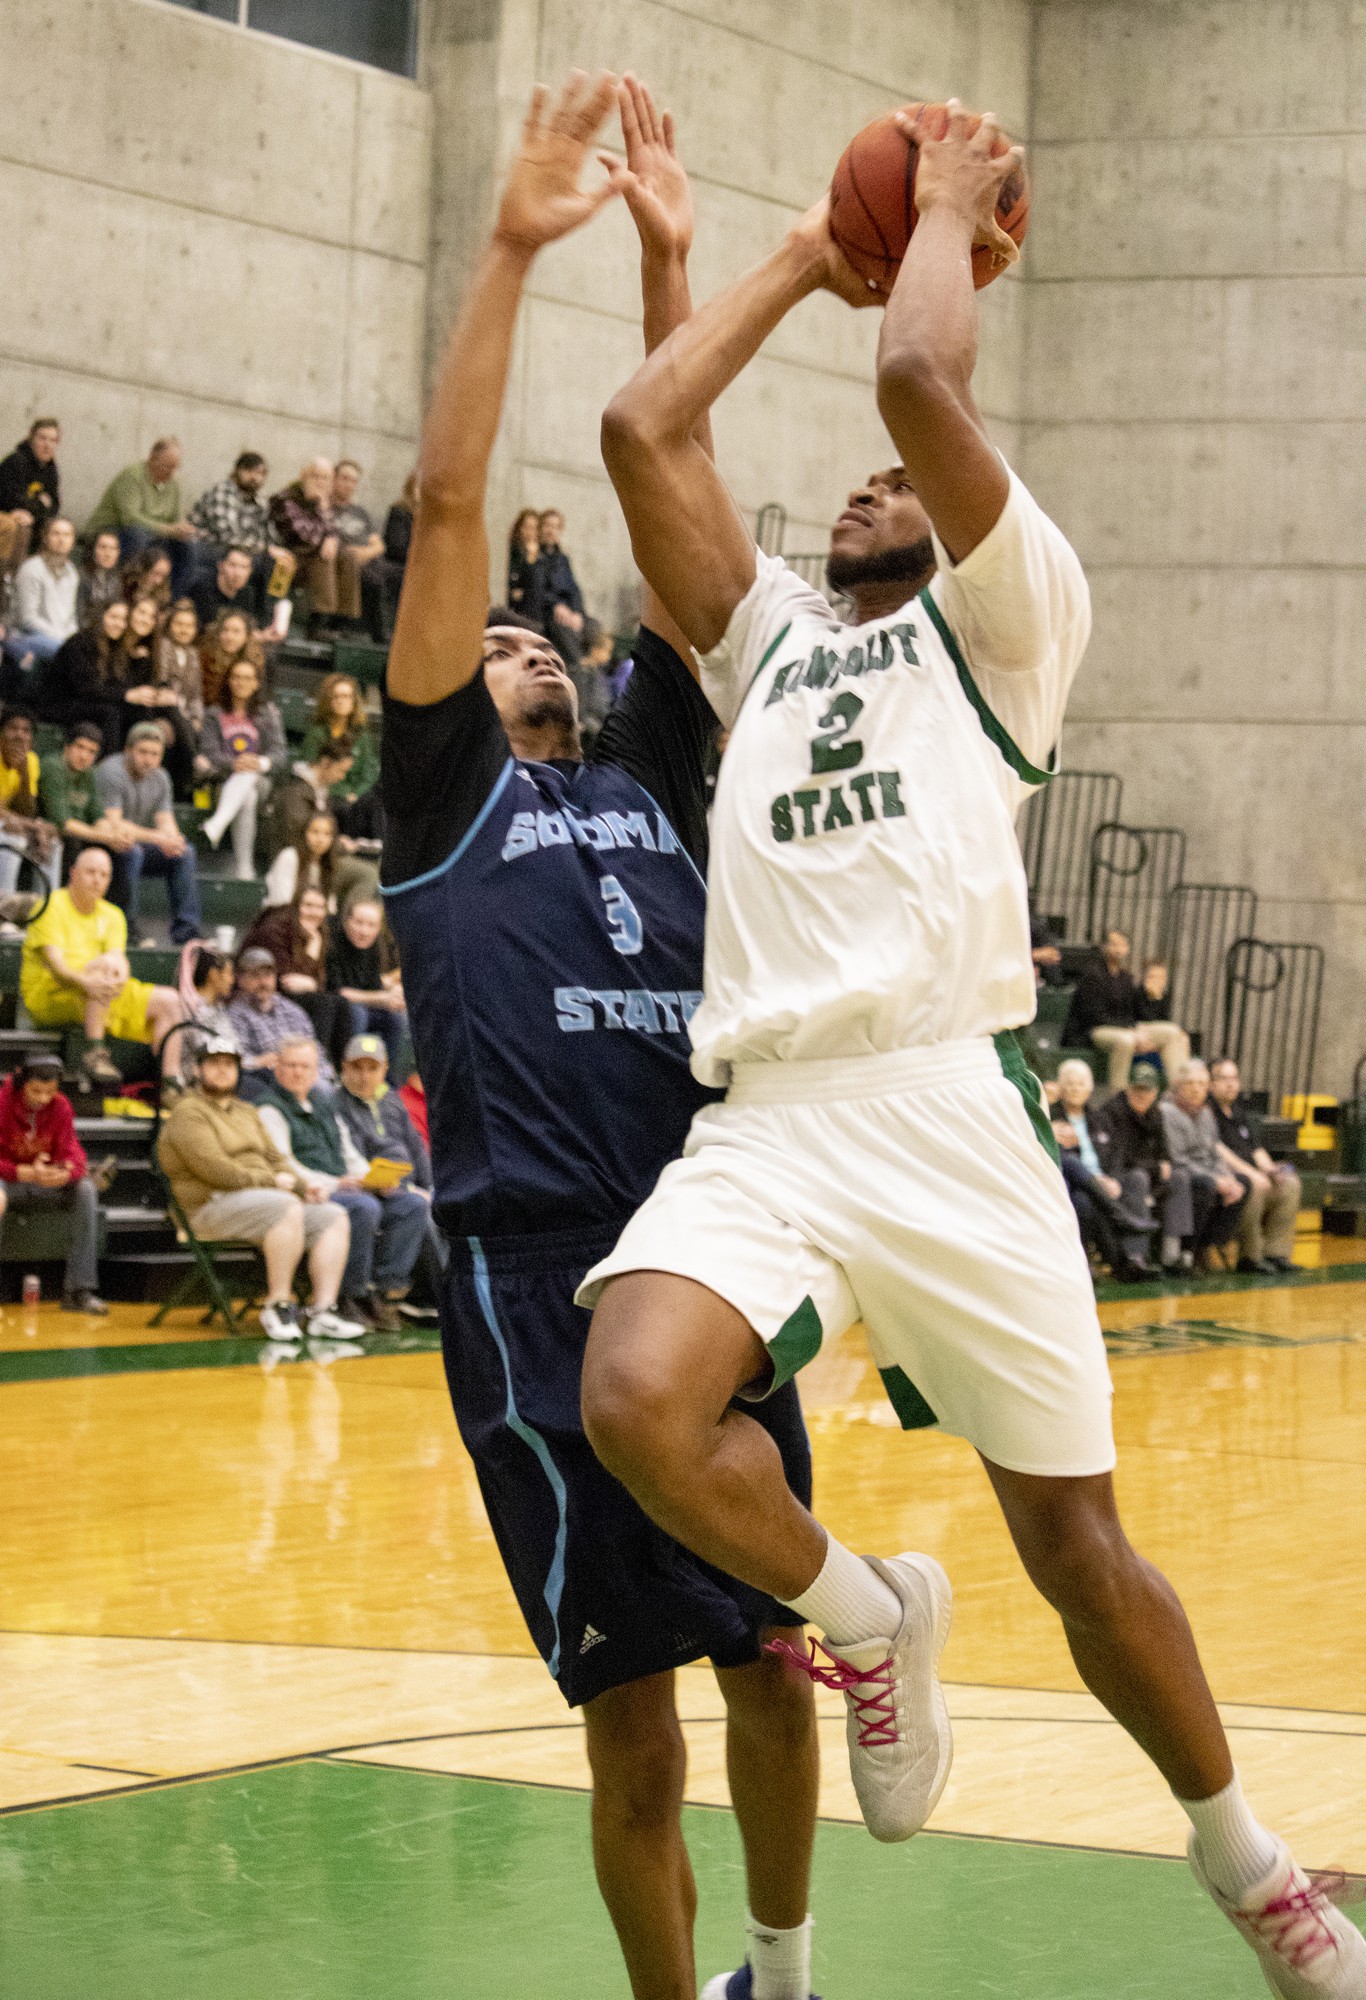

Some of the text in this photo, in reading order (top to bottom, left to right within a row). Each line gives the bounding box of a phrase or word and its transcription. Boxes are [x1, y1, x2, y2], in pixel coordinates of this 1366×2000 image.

[810, 691, 864, 775] 2
[770, 770, 907, 844] STATE
[600, 874, 643, 955] 3
[579, 1634, 607, 1654] adidas
